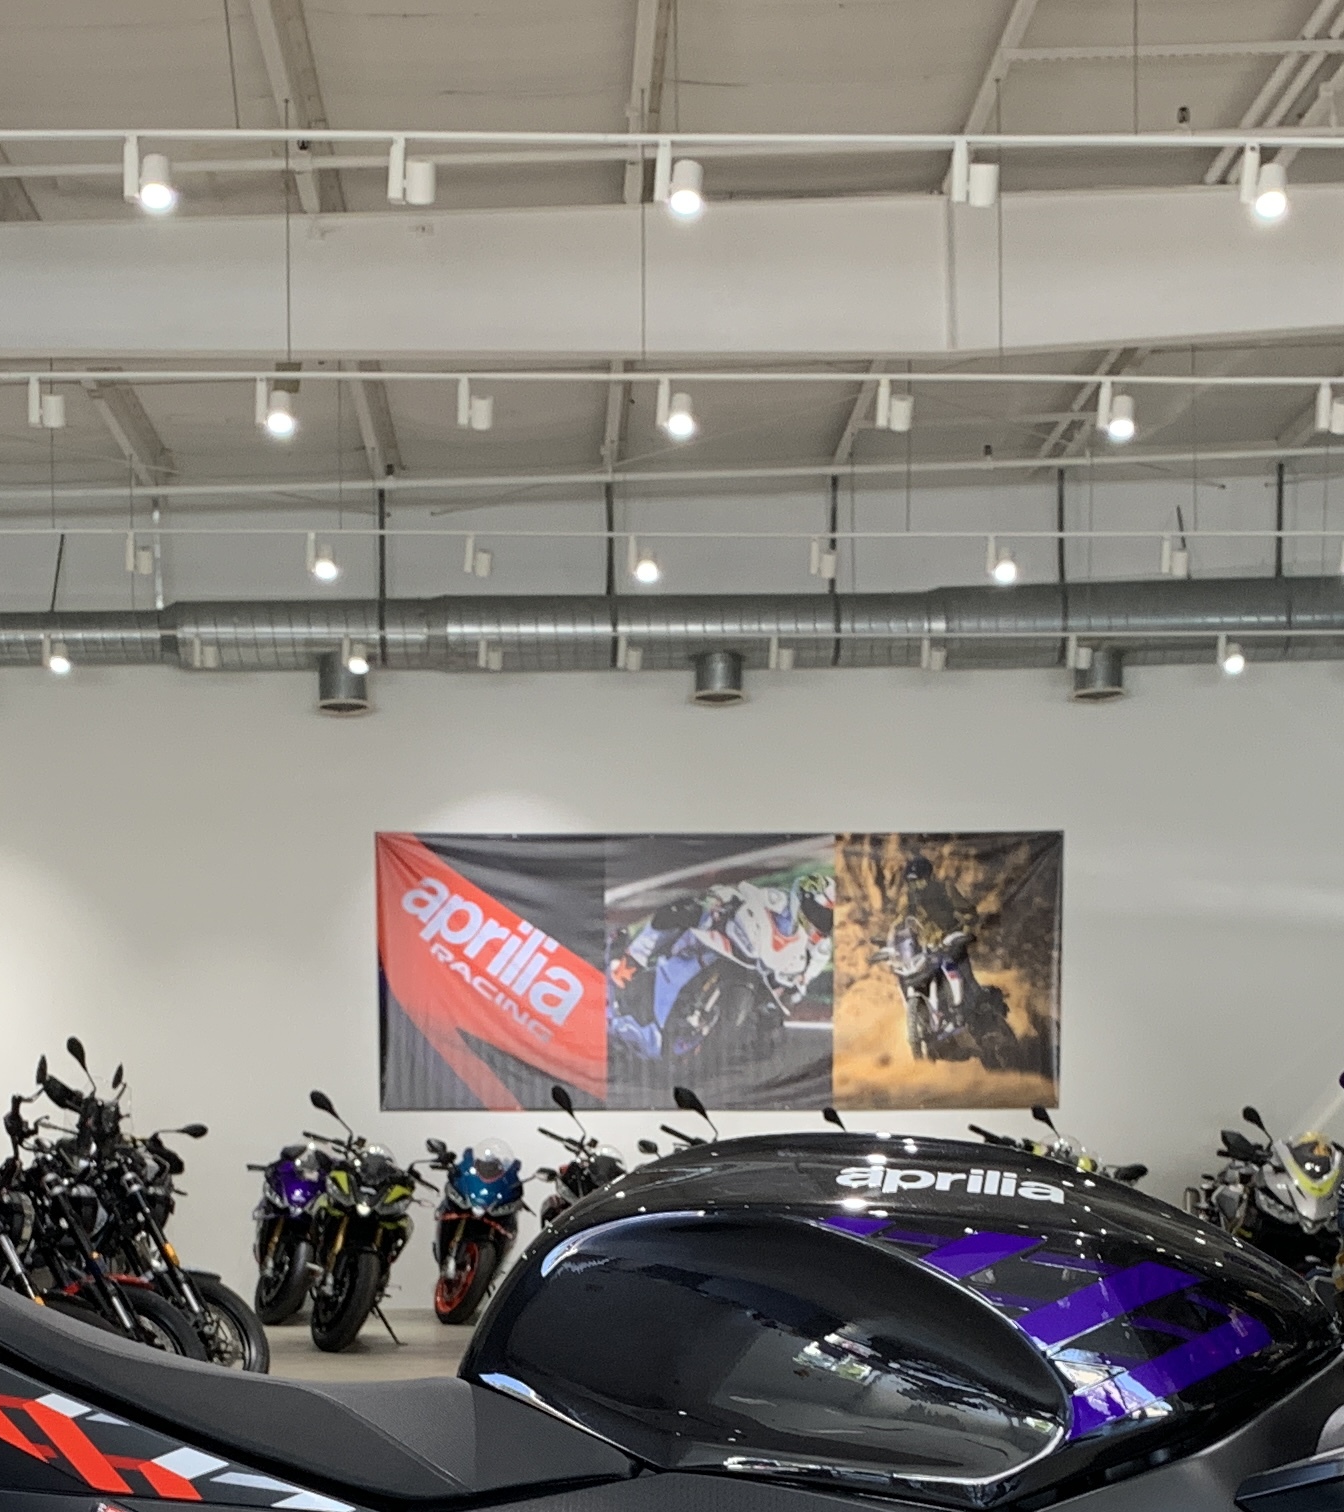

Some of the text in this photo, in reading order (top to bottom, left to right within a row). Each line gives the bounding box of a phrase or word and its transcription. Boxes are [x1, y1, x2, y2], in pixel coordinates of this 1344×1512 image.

[401, 876, 584, 1026] aprilia
[430, 943, 554, 1044] RACING
[835, 1165, 1065, 1205] aprilia
